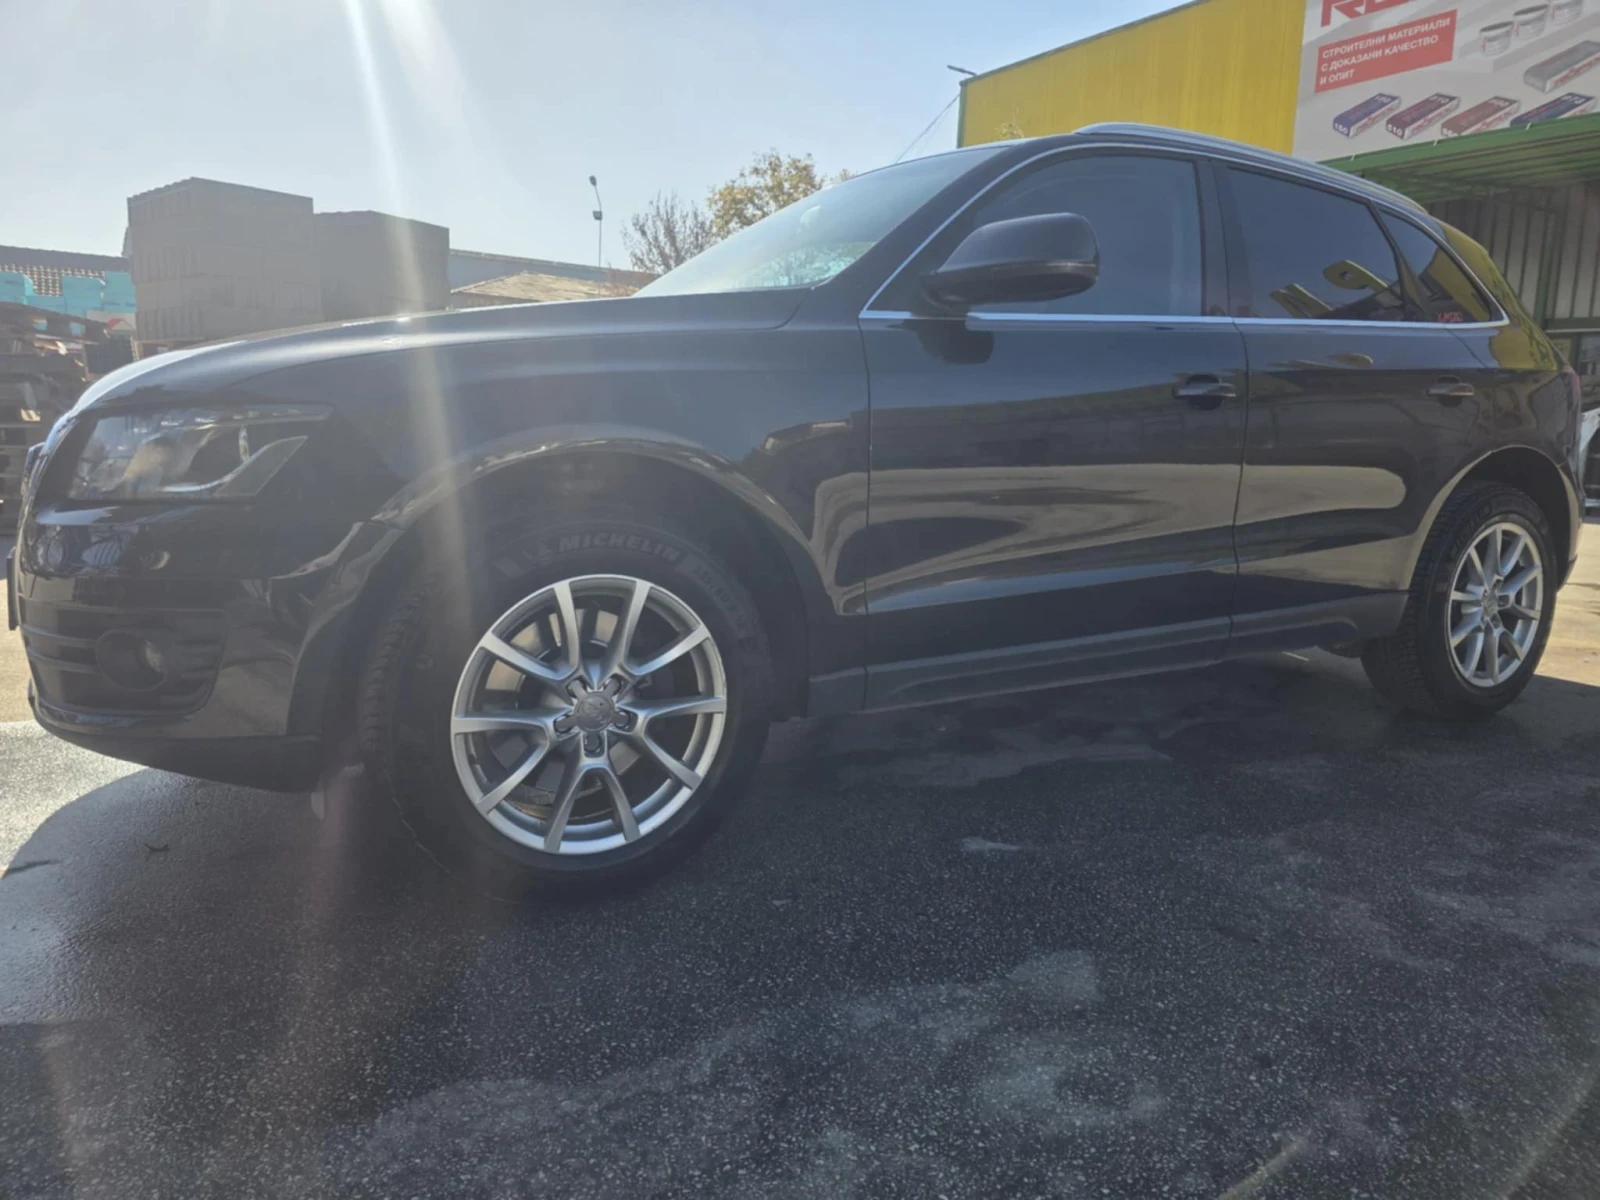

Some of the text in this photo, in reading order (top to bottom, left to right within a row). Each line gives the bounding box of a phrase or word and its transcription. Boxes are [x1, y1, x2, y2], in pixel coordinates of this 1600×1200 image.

[1321, 35, 1439, 72] С ДОКАЗАНИ КАЧЕСТВО
[1322, 17, 1451, 59] СТРОИТЕЛНИ МАТЕРИАЛИ
[1320, 69, 1355, 85] И ОПИТ
[558, 531, 681, 562] MICHELIN
